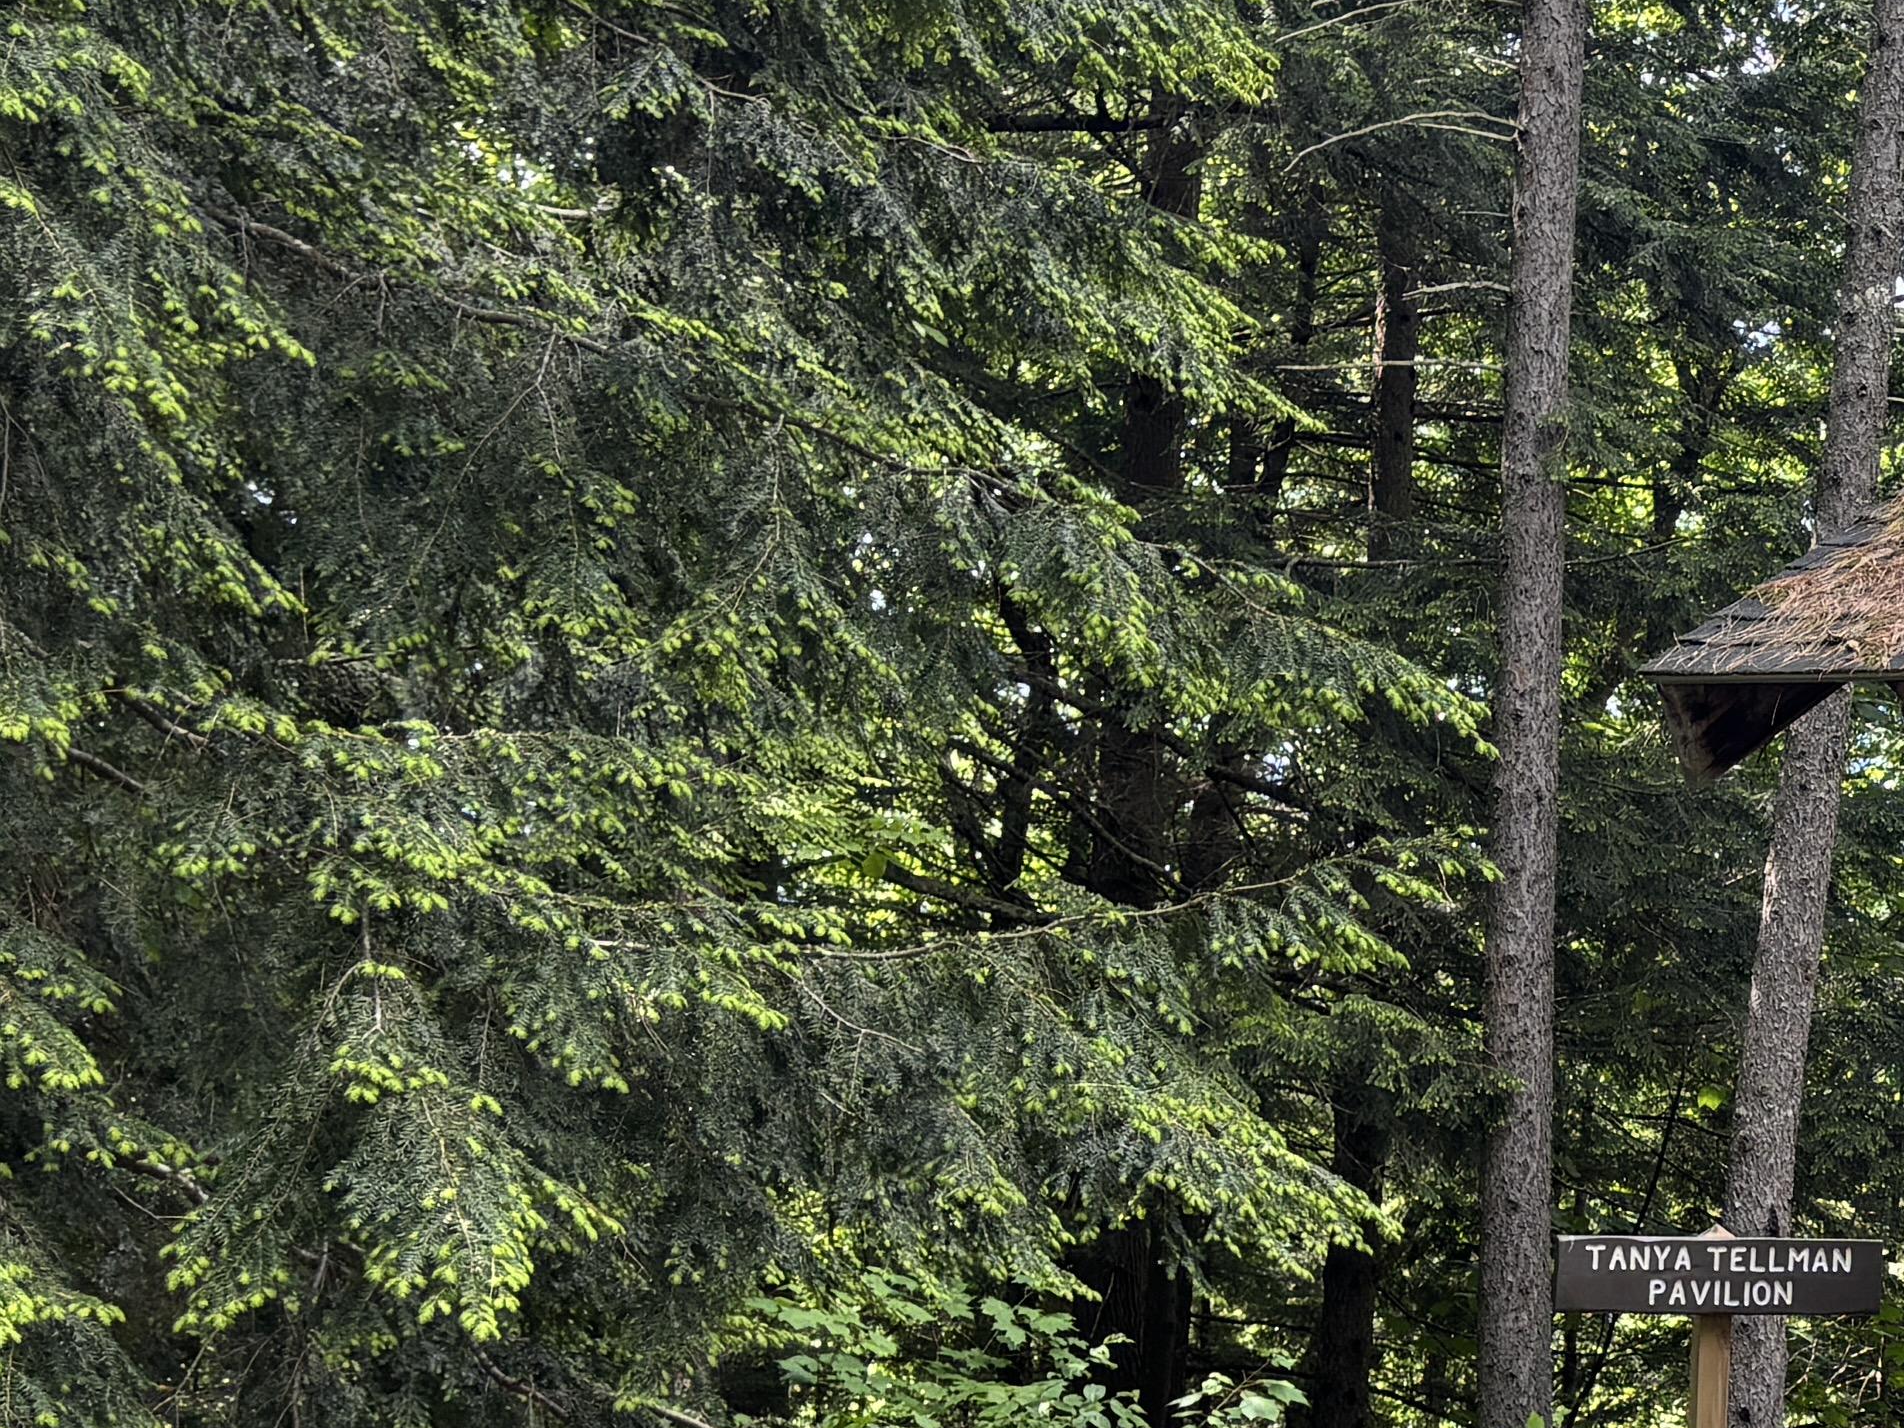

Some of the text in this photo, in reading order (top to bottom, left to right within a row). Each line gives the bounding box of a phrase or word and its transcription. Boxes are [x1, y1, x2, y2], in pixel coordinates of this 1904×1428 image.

[1585, 1244, 1852, 1273] TANYA TELLMAN
[1648, 1279, 1794, 1306] PAVILION
